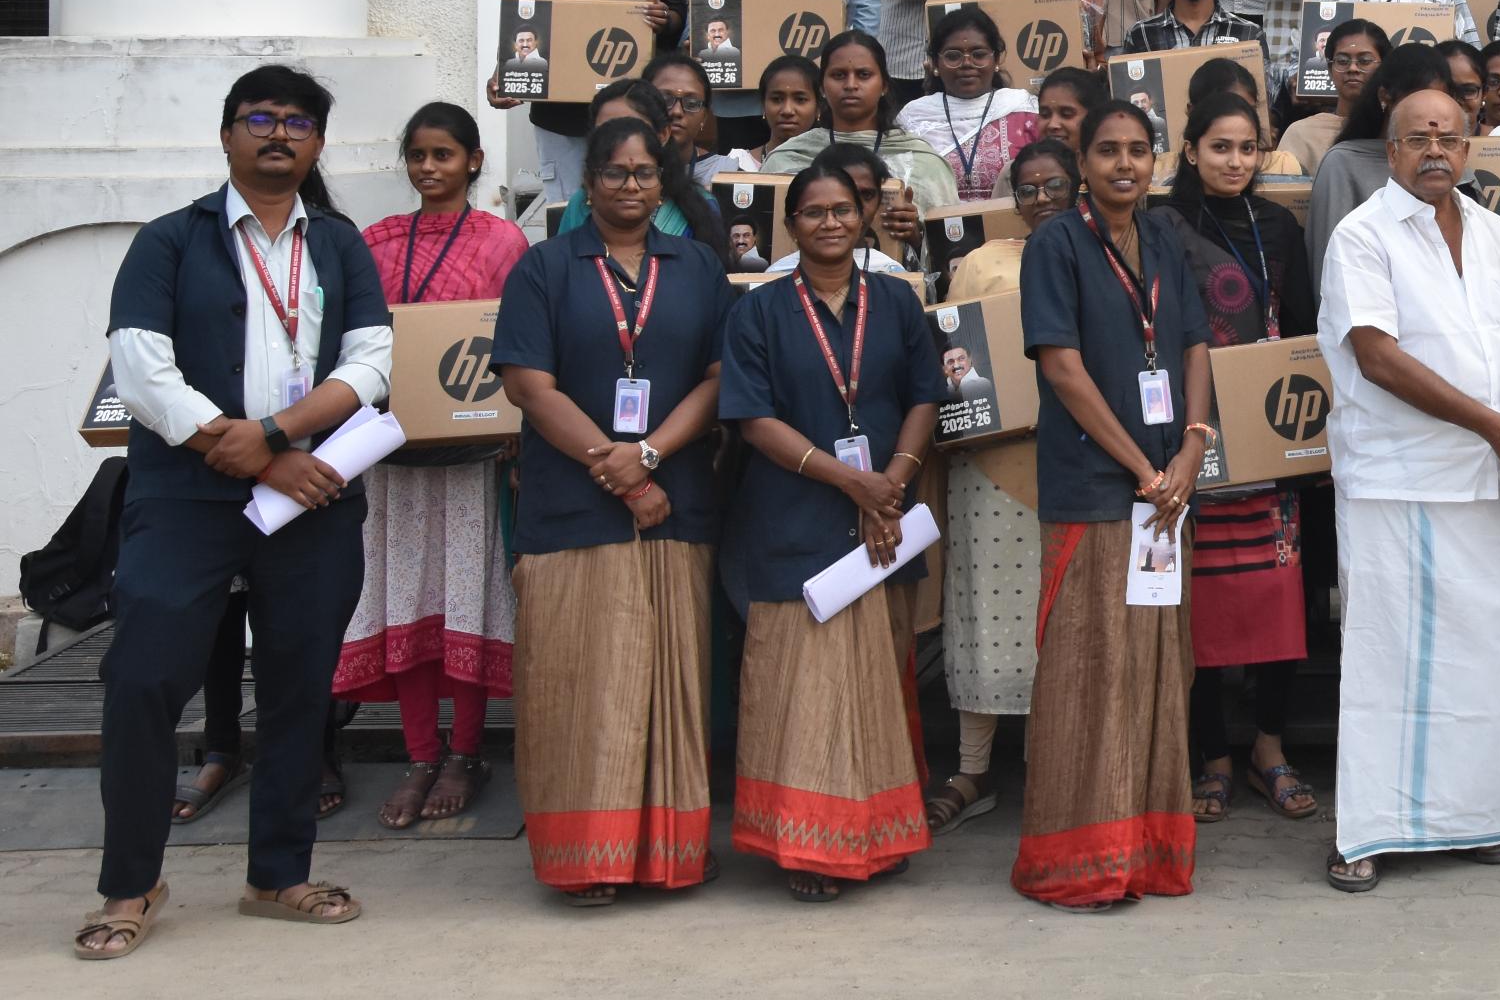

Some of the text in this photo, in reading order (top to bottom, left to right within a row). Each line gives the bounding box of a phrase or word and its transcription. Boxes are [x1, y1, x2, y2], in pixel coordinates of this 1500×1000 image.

[592, 27, 633, 78] hp
[785, 12, 825, 57] hp
[1023, 20, 1062, 71] hp
[504, 82, 542, 94] 2025-26
[1304, 80, 1336, 91] 2025-2
[446, 338, 495, 402] hp
[940, 401, 969, 413] தமிழ்நாடு
[942, 412, 991, 433] 2025-26
[1275, 374, 1322, 441] hp
